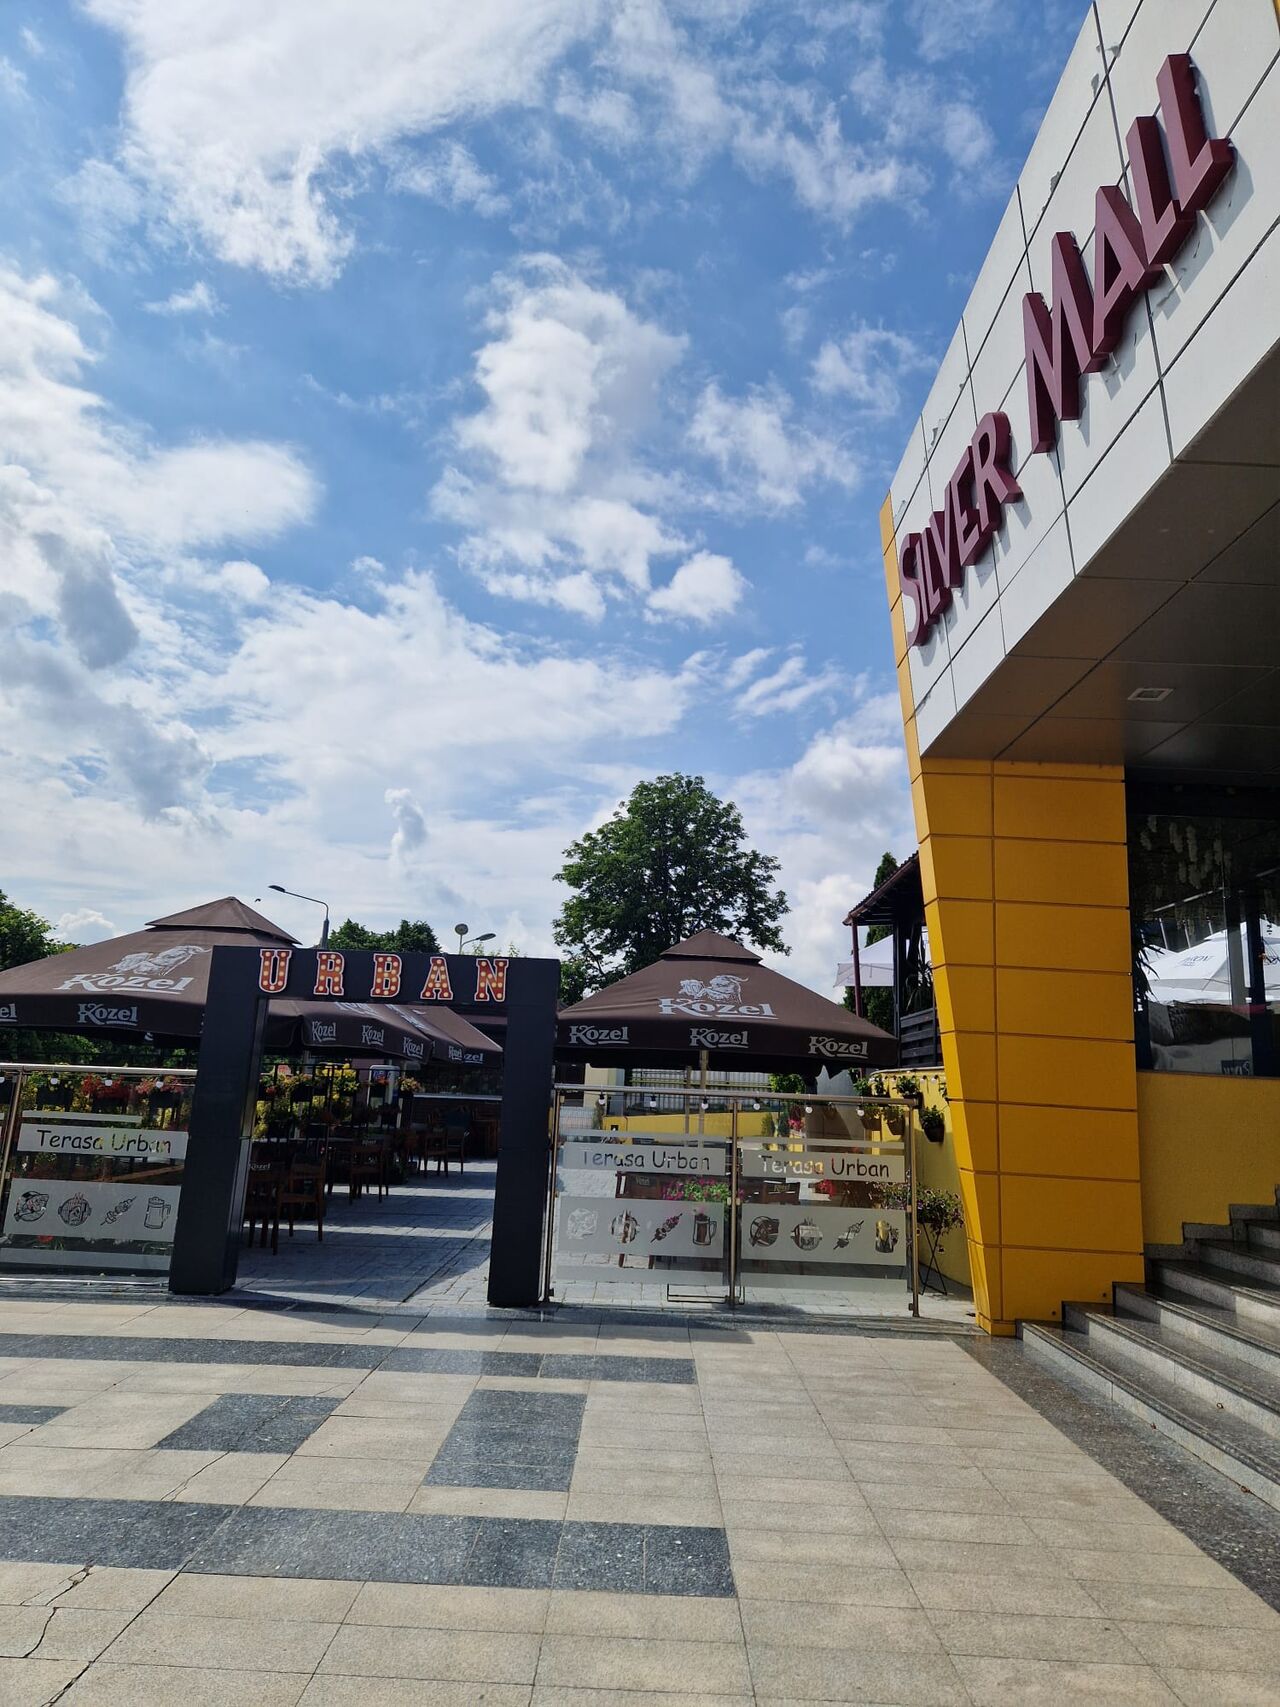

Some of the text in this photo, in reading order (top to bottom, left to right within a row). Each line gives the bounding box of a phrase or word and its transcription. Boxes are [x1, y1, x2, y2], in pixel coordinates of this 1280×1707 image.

[900, 53, 1235, 647] SILVER MALL
[53, 972, 195, 993] Kozel
[259, 949, 509, 1002] URBAN
[78, 1003, 139, 1026] Kozel
[658, 998, 778, 1018] Kozel
[312, 1020, 337, 1041] Kozel
[362, 1024, 385, 1045] Kozel
[569, 1025, 630, 1045] Kozel
[690, 1028, 749, 1048] Kozel
[403, 1036, 424, 1058] Kozel
[808, 1036, 869, 1058] Kozel
[37, 1129, 171, 1154] Terasa Urban
[582, 1149, 710, 1171] Terasa Urban
[759, 1154, 889, 1178] Terasa Urban
